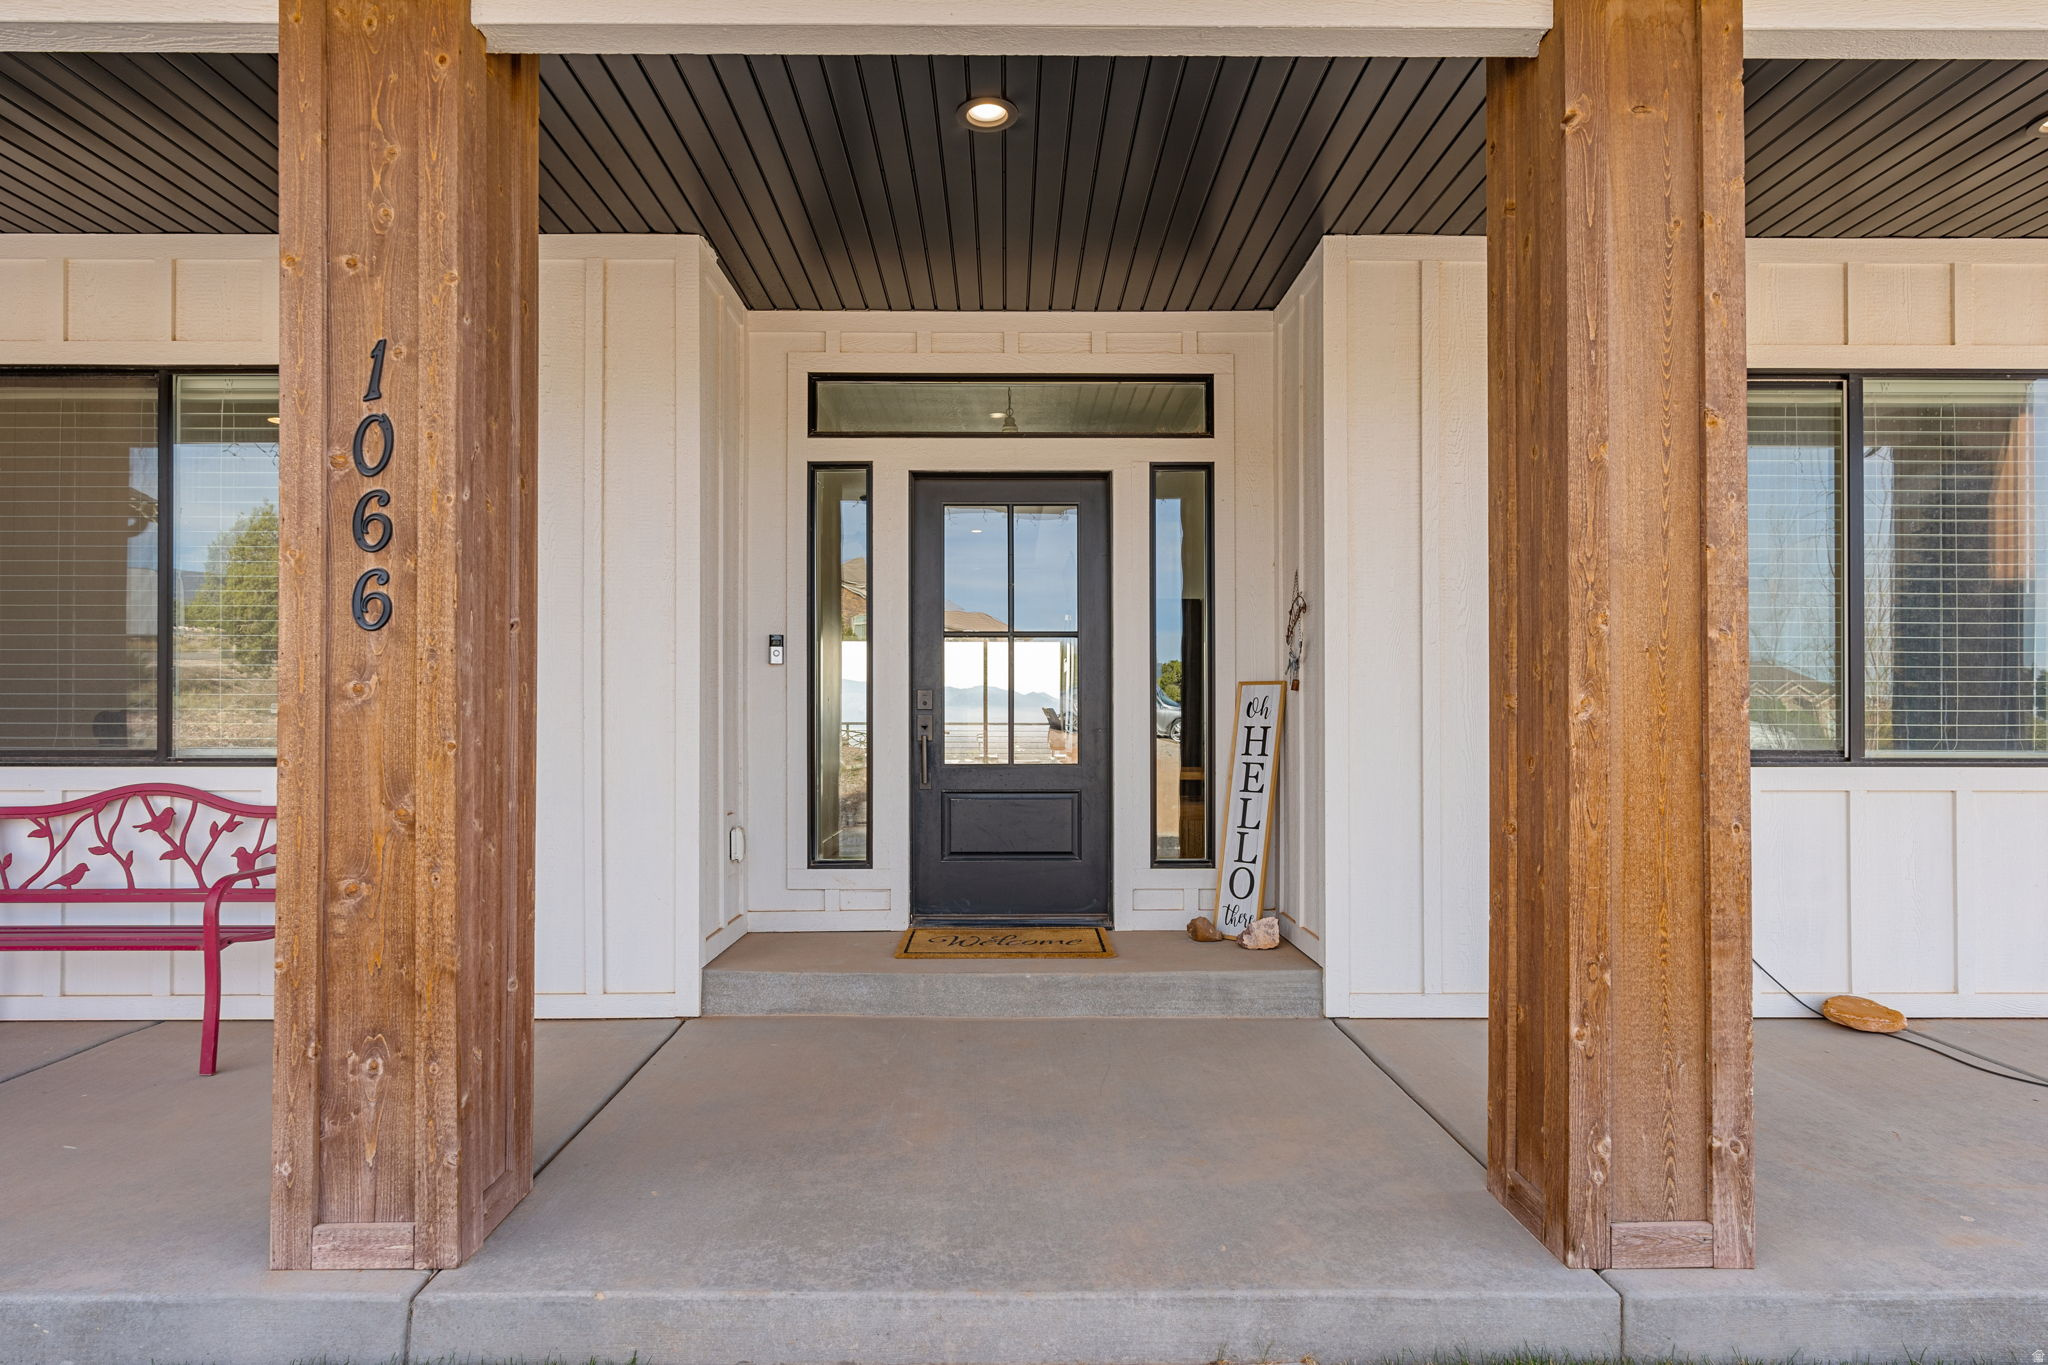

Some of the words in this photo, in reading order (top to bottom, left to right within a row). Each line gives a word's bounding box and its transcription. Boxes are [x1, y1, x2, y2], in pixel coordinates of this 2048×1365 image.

[352, 338, 394, 632] 1066
[1228, 725, 1272, 900] HELLO
[928, 934, 1083, 948] Welcome
